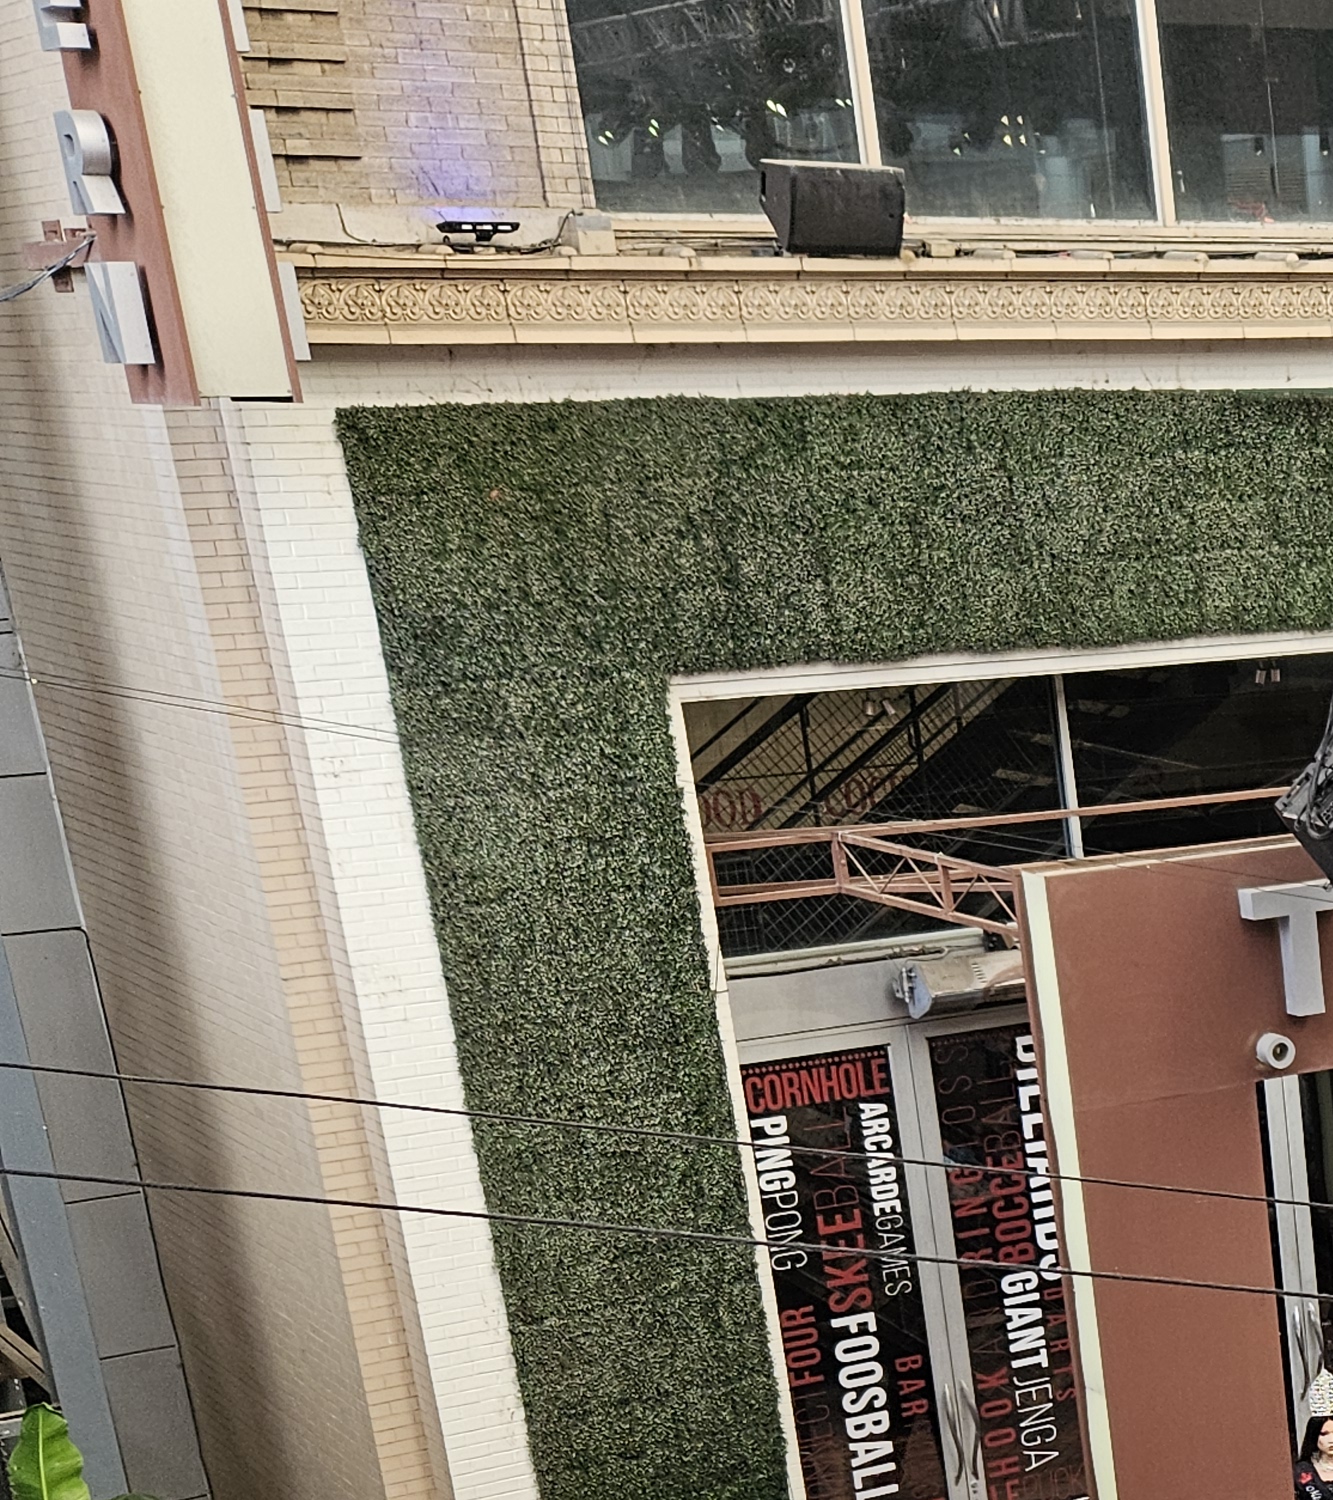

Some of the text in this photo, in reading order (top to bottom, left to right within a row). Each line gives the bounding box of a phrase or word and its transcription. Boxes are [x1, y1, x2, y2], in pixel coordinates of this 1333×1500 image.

[744, 1058, 890, 1114] CORNHOLE
[780, 1305, 825, 1389] FOUR
[1000, 1270, 1049, 1370] GIANT
[895, 1354, 930, 1418] BAR
[1013, 1376, 1060, 1473] JENGA
